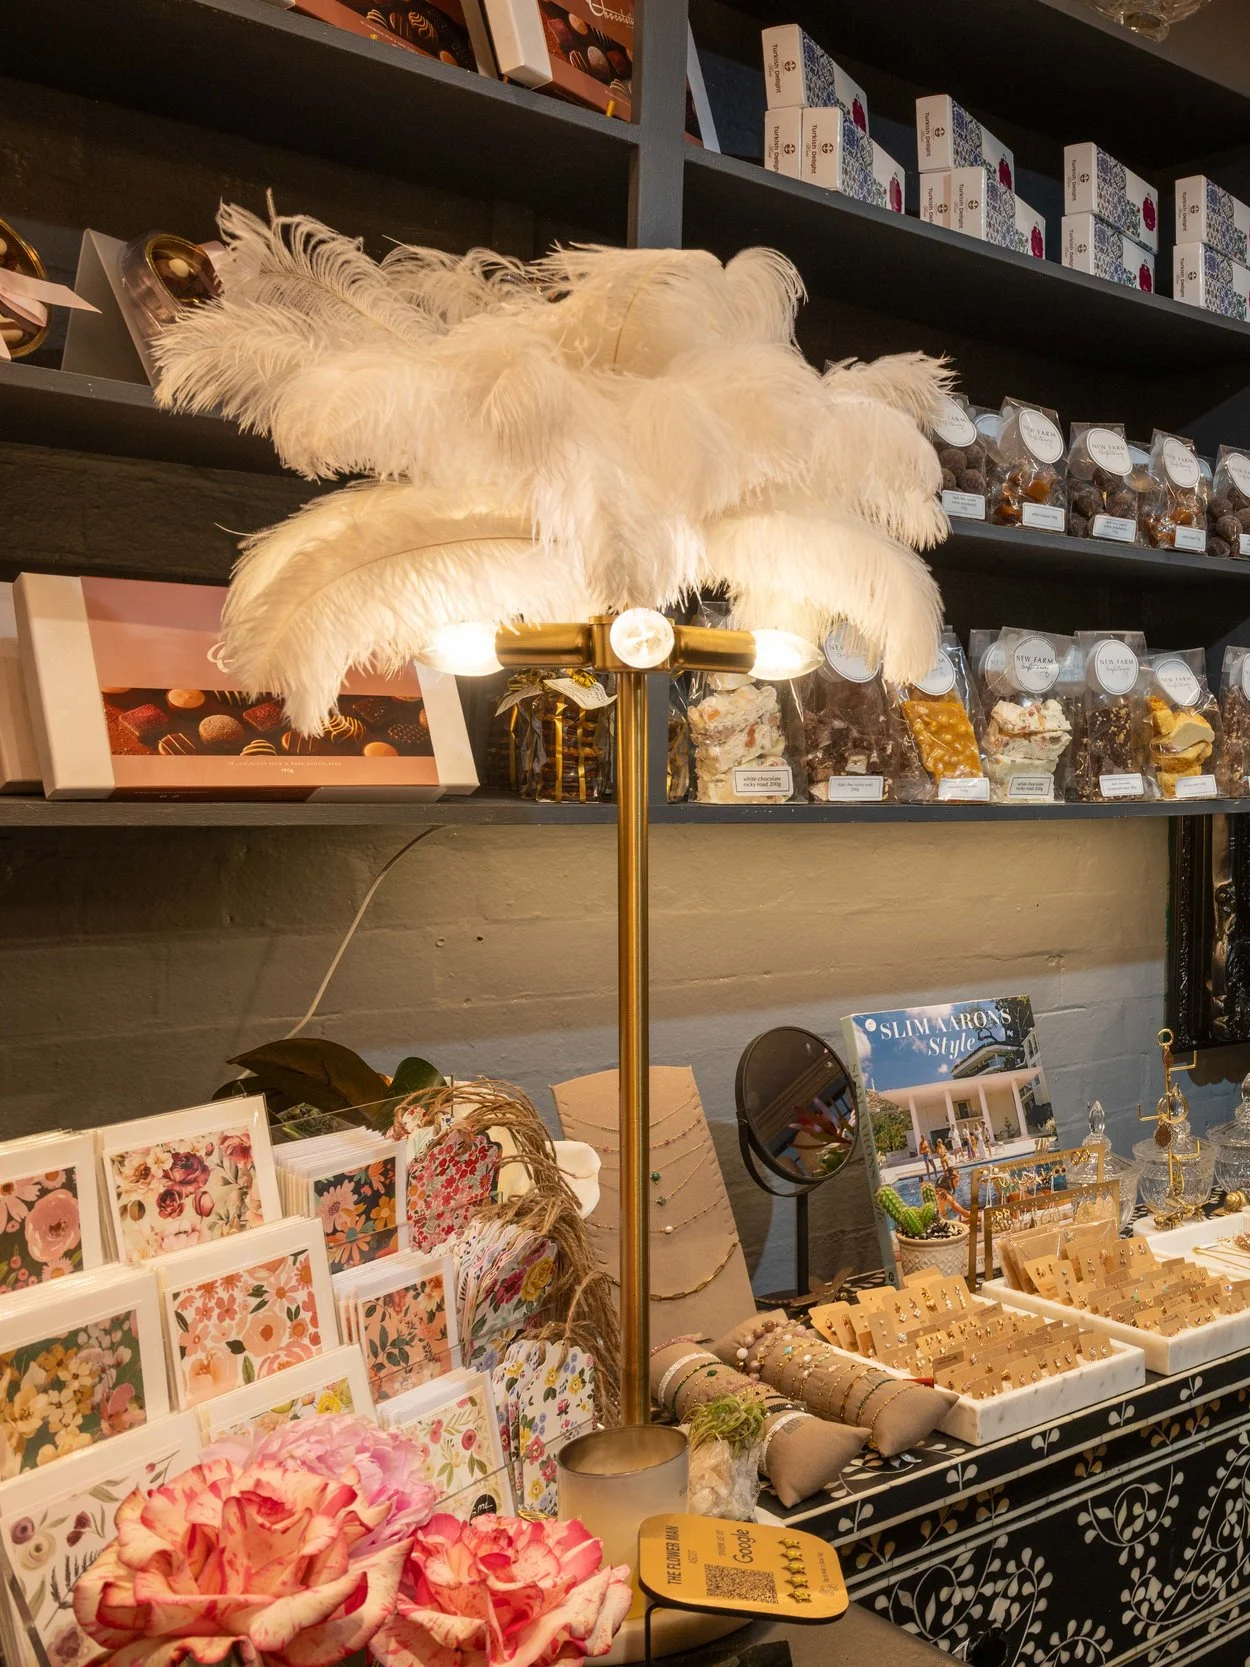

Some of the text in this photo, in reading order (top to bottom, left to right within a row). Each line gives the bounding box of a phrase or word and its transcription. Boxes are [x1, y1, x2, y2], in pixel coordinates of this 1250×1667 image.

[1033, 656, 1054, 664] FARM
[880, 1008, 1012, 1040] SLIM AARONS
[928, 1032, 976, 1060] Style
[664, 1525, 682, 1585] THE FLOWER MAN
[730, 1529, 756, 1564] Google
